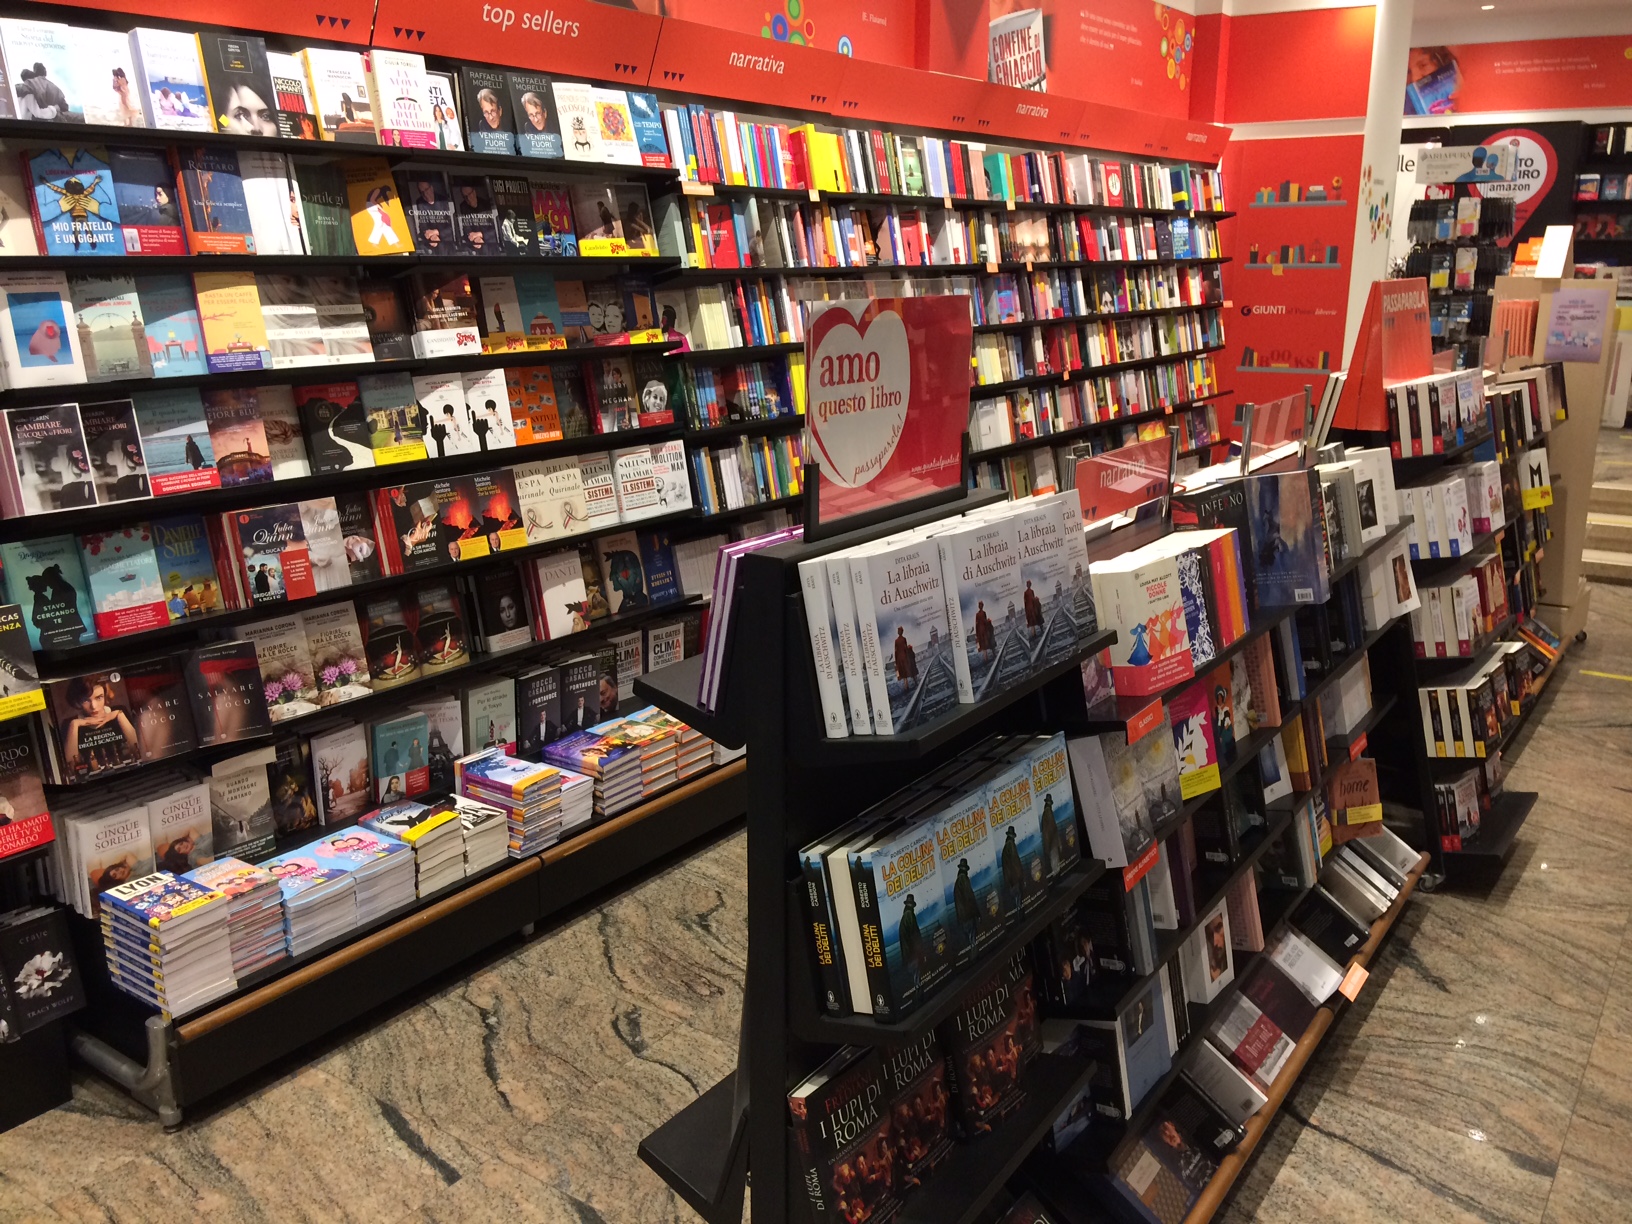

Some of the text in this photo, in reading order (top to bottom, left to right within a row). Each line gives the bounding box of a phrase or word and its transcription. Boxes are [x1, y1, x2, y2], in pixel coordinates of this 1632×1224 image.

[483, 3, 580, 38] top sellers
[992, 26, 1033, 64] CONFINE
[729, 48, 785, 74] narrativa
[470, 72, 504, 82] RAFFAELE
[472, 79, 502, 88] MORELLI
[512, 76, 547, 86] RAFFAELE
[516, 84, 547, 92] MORELLI
[1016, 103, 1049, 118] narrativa
[642, 121, 662, 129] TEMPO
[479, 132, 509, 140] VENIRNE
[485, 140, 506, 148] FUORI
[525, 134, 556, 142] VENIRNE
[188, 160, 234, 172] RATTARO
[1489, 183, 1531, 193] amazon
[52, 222, 112, 231] MIO FRATELLO
[64, 234, 76, 243] UN
[78, 233, 114, 242] GIGANTE
[1384, 291, 1426, 314] PASSAPAROLA
[820, 352, 881, 388] amo
[603, 396, 633, 404] MEGHAN
[818, 386, 902, 424] questo libro
[208, 410, 236, 420] FIORE
[16, 421, 62, 432] CAMBIARE
[853, 413, 904, 484] passaparola!
[546, 462, 578, 474] BRUNO
[619, 458, 651, 468] SALLUSTI
[671, 462, 685, 472] MAN
[549, 474, 578, 484] VESPA
[621, 470, 654, 480] PALAMARA
[1100, 456, 1146, 488] narrativa
[1529, 462, 1543, 488] M
[550, 484, 581, 496] Quirinale
[588, 488, 612, 499] SISTEMA
[623, 480, 654, 493] IL SISTEMA
[1200, 492, 1244, 517] INFERNO
[273, 521, 294, 535] Julia
[1024, 514, 1047, 526] DITA KRAUS
[154, 524, 200, 546] DANIELLE
[252, 529, 294, 545] Quinn
[1018, 522, 1057, 543] La libraia
[164, 540, 199, 558] STEEL
[969, 540, 1009, 562] La libraia
[545, 566, 578, 582] DANTE
[887, 562, 930, 584] La libraia
[962, 555, 1017, 581] di Auschwitz
[880, 577, 940, 606] di Auschwitz
[1146, 580, 1168, 593] PICCOLE
[1148, 588, 1166, 599] DONNE
[254, 590, 286, 600] BRIDGERTON
[37, 608, 76, 620] CERCANDO
[43, 603, 66, 612] STAVO
[245, 622, 296, 637] MARIANNA CORONA
[320, 628, 342, 638] FIORIRE
[334, 631, 352, 640] ROCCE
[654, 629, 681, 641] BILL GATES
[262, 643, 287, 652] FIORIRE
[278, 646, 298, 655] ROCCE
[654, 639, 681, 656] CLIMA
[814, 634, 825, 673] LA LIBRAIA
[818, 626, 833, 680] DI AUSCHWITZ
[840, 630, 849, 670] LA LIBRAIA
[843, 622, 856, 676] DI AUSCHWITZ
[565, 670, 596, 684] CASALINO
[570, 664, 592, 675] ROCCO
[198, 684, 254, 699] SALVARE
[528, 682, 556, 698] CASALINO
[532, 677, 553, 690] ROCCO
[208, 698, 251, 712] FUOCO
[78, 734, 124, 750] DEGLI SCACCHI
[94, 732, 116, 741] REGINA
[1032, 749, 1065, 778] A COLLINA
[226, 777, 249, 788] QUANDO
[1340, 779, 1370, 798] home
[226, 792, 252, 803] CANTANO
[988, 778, 1031, 812] LA COLLINA
[162, 796, 202, 816] CINQUE
[990, 792, 1032, 828] DEI DELITTI
[162, 805, 204, 826] SORELLE
[21, 830, 30, 838] TV
[33, 825, 43, 833] SU
[96, 820, 140, 840] CINQUE
[936, 808, 986, 846] LA COLLINA
[95, 830, 142, 851] SORELLE
[890, 834, 928, 859] ROBERTO CARBONI
[940, 822, 988, 861] DEI DELITTI
[882, 842, 935, 880] LA COLLINA
[115, 876, 164, 895] LYON
[886, 858, 936, 897] DEI DELITTI
[862, 882, 870, 908] CARBONI
[27, 996, 74, 1018] TRACY WOLFF
[956, 984, 1010, 1032] I LUPI DI
[968, 1006, 1006, 1042] ROMA
[882, 1030, 936, 1080] I LUPI DI
[894, 1051, 934, 1090] ROMA
[819, 1079, 882, 1138] I LUPI DI
[834, 1104, 878, 1150] ROMA
[810, 1167, 825, 1211] DI ROMA
